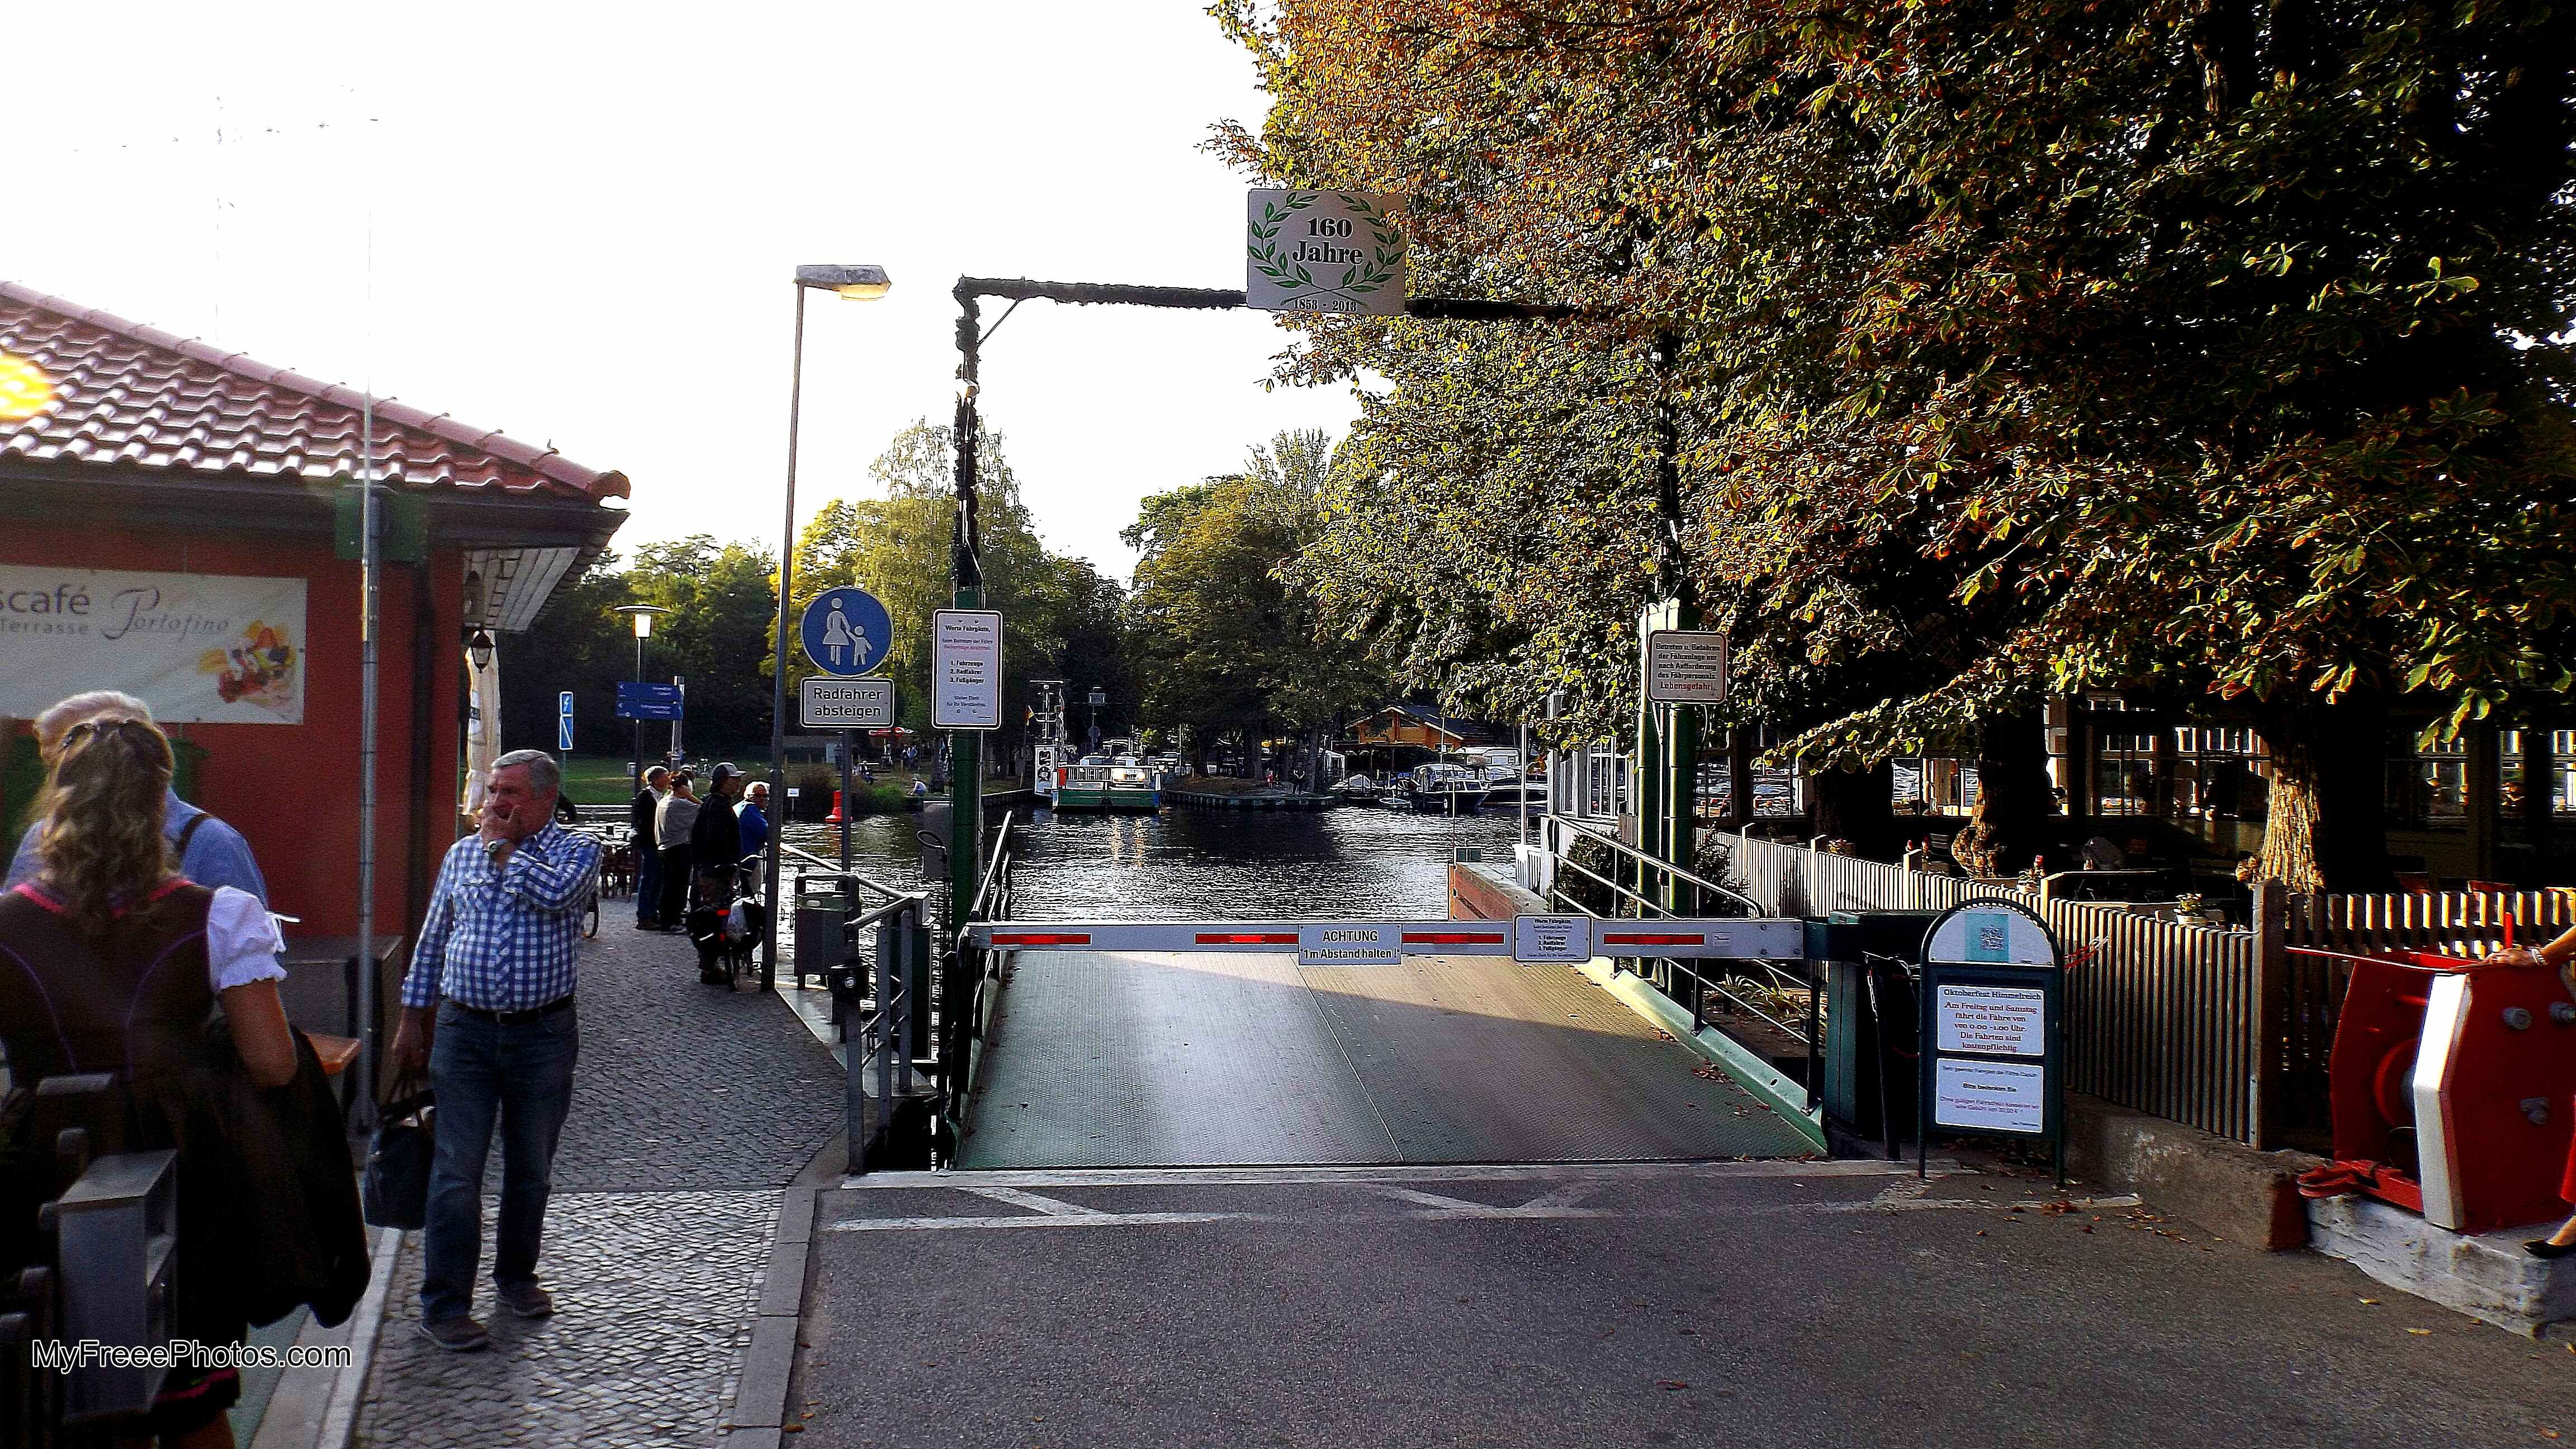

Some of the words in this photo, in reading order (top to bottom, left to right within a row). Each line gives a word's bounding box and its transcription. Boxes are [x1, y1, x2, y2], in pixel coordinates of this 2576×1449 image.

[1307, 217, 1353, 238] 160
[1292, 240, 1363, 265] Jahre
[1332, 300, 1357, 312] 2013
[101, 585, 229, 641] Portofino
[1660, 681, 1713, 691] Lebensgefahr!
[813, 687, 883, 700] Radfahrer
[815, 704, 882, 719] absteigen
[1322, 930, 1379, 942] ACHTUNG
[1320, 948, 1360, 959] Abstand
[1361, 948, 1392, 958] halten
[1943, 988, 1991, 998] Oktoberfest
[1992, 991, 2042, 1000] Himmelreich
[1961, 1002, 1987, 1011] Freitag
[2005, 1005, 2037, 1014] Samstag
[1975, 1033, 2004, 1041] Fahrten
